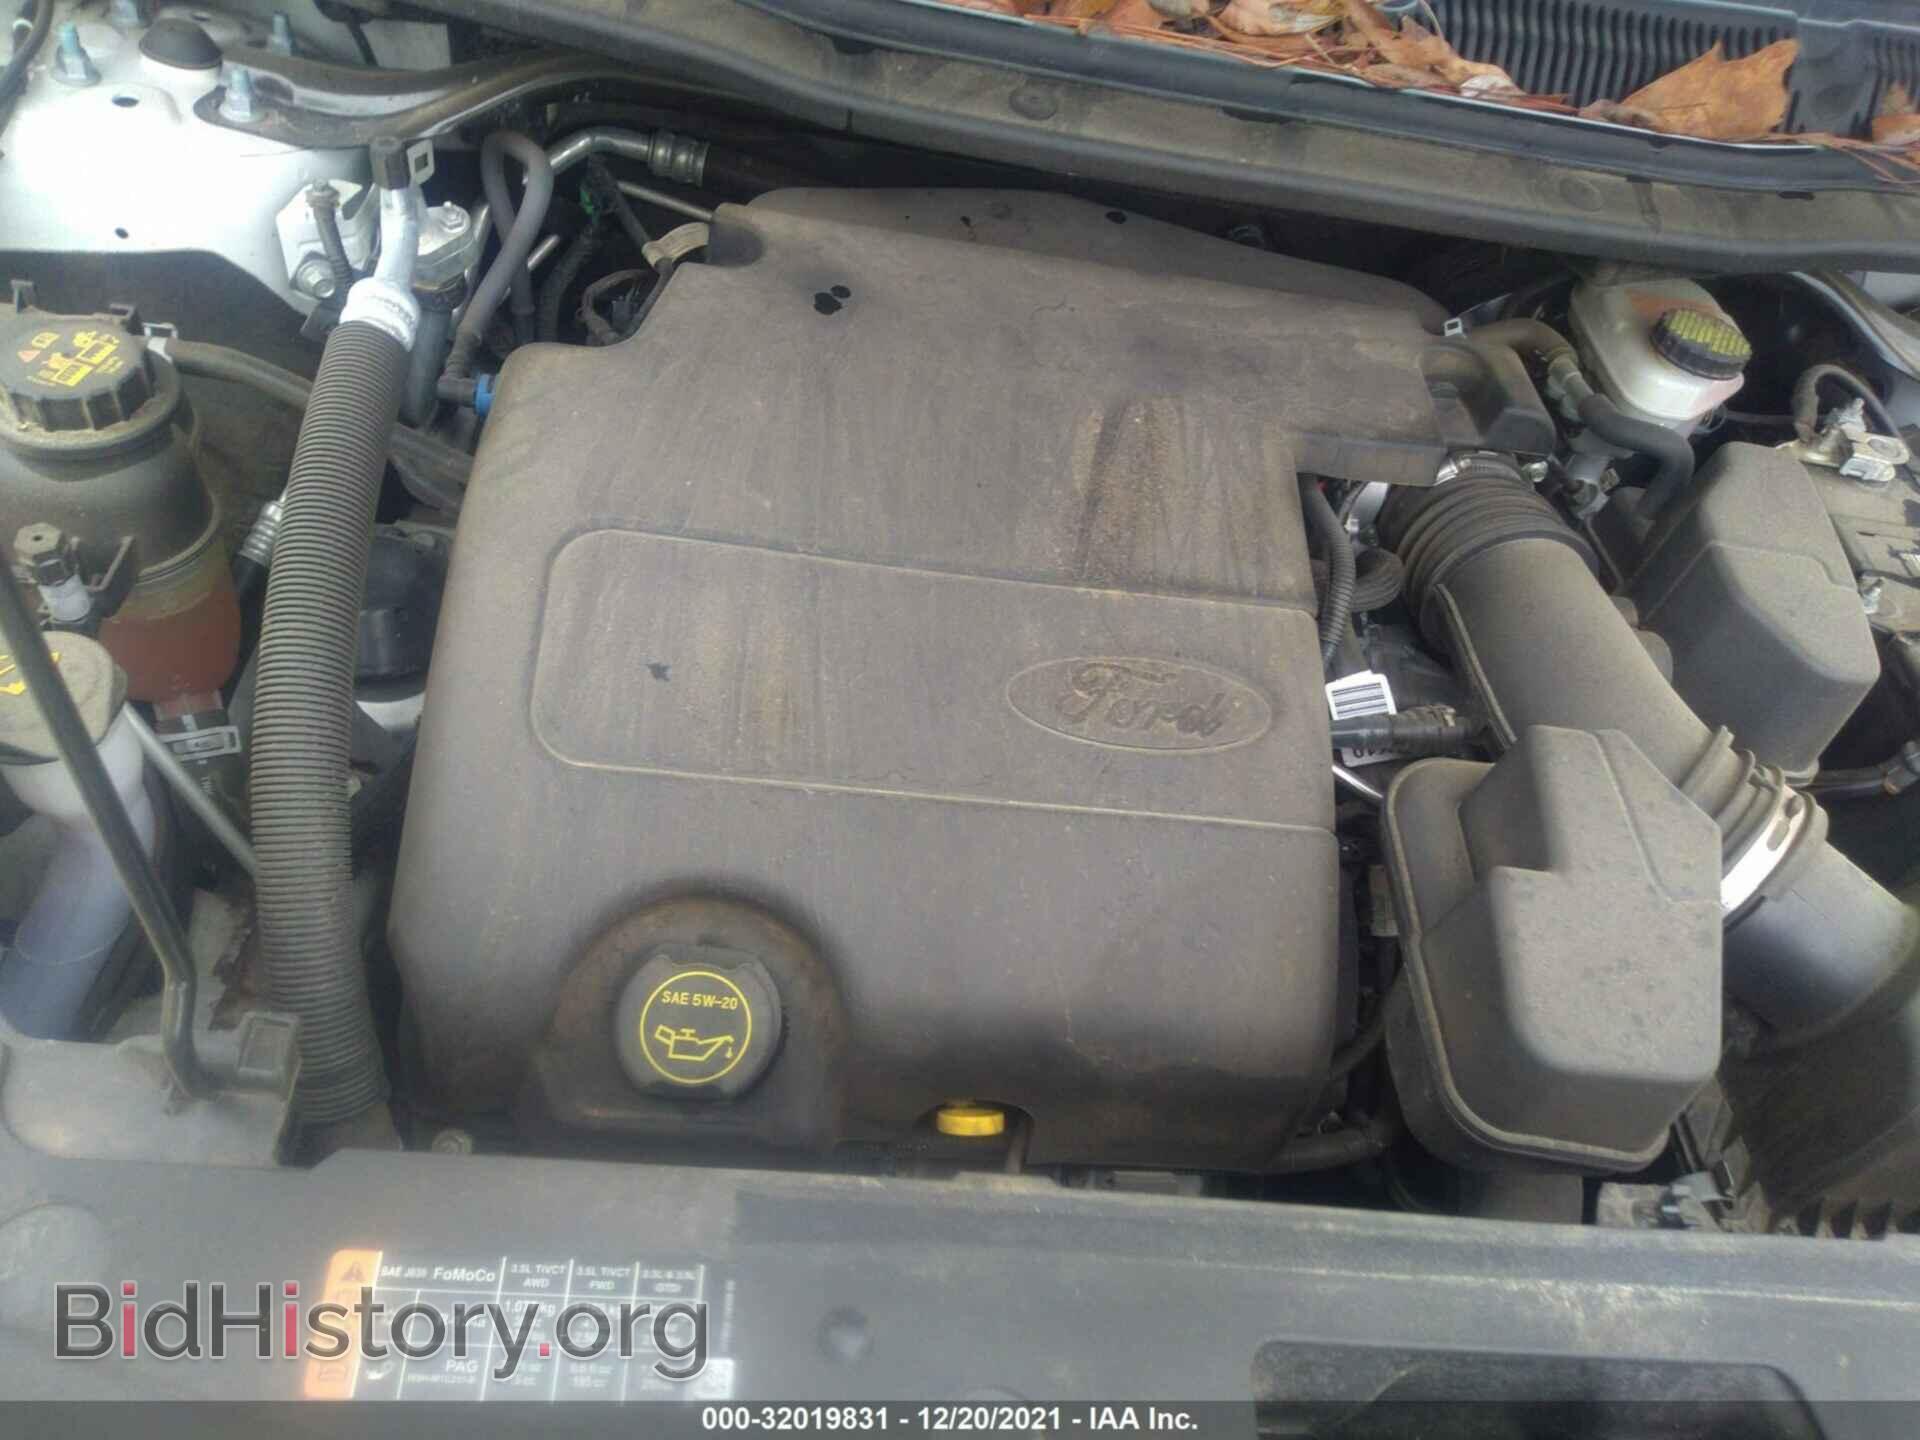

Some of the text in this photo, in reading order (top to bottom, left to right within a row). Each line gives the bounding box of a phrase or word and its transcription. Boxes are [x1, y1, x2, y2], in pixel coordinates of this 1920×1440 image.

[1054, 662, 1226, 738] Ford
[662, 990, 739, 1011] SAE 5W-20
[433, 1266, 496, 1283] FoMoCo
[522, 1277, 551, 1289] AWD
[445, 1360, 479, 1374] PAG
